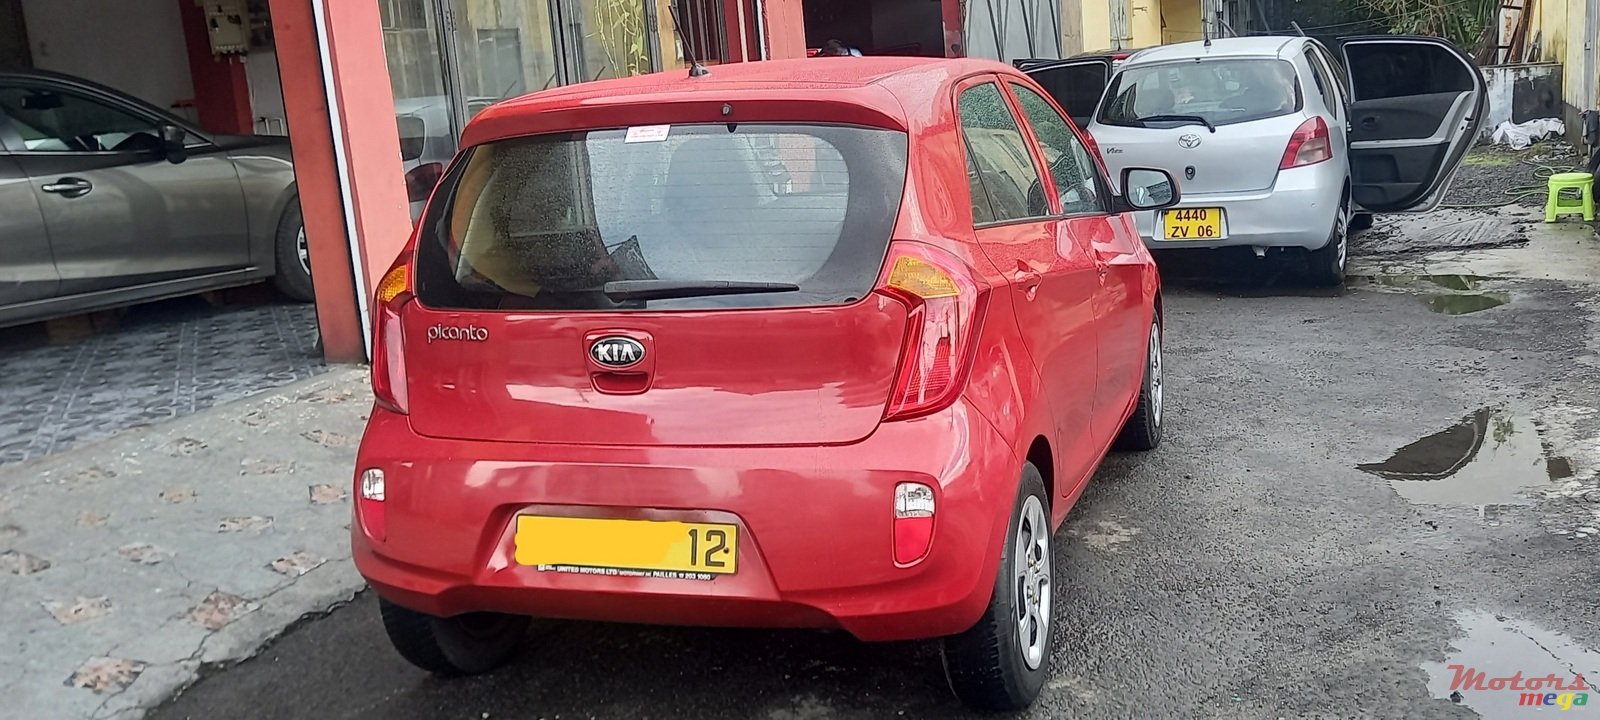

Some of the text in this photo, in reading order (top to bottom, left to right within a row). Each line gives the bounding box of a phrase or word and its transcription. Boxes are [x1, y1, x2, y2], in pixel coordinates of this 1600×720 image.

[1175, 209, 1207, 221] 4440
[1171, 225, 1213, 238] ZV 06
[427, 324, 489, 343] picanto
[598, 343, 636, 361] KIA
[688, 529, 726, 567] 12
[580, 567, 605, 575] MOTORS
